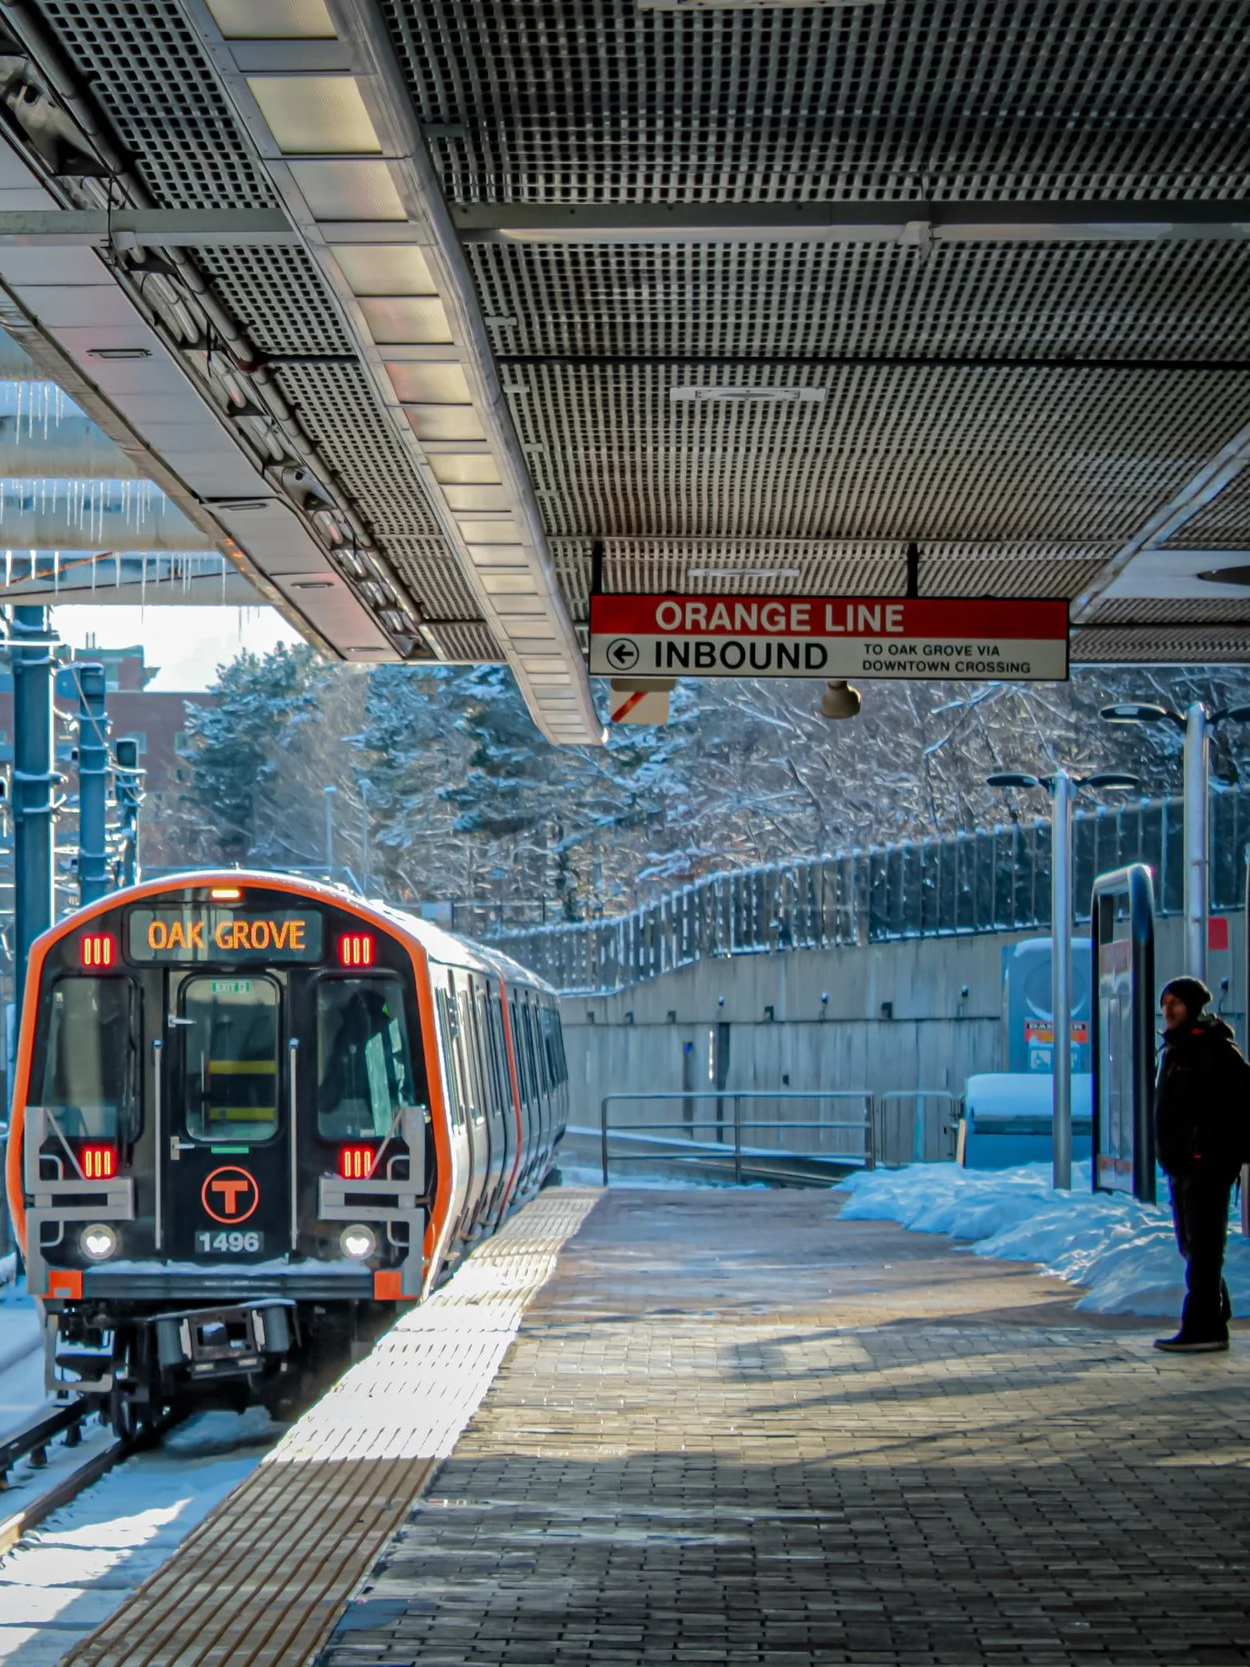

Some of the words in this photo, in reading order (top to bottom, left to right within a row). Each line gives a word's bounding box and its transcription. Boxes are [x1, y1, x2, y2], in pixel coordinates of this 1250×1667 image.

[655, 600, 811, 632] ORANGE
[825, 603, 904, 632] LINE
[655, 640, 828, 670] INBOUND
[863, 643, 883, 656] TO
[888, 643, 918, 656] OAK
[922, 644, 973, 657] GROVE
[977, 645, 1000, 657] VIA
[862, 660, 950, 672] DOWNTOWN
[955, 661, 1031, 674] CROSSING
[147, 920, 205, 949] OAK
[214, 920, 306, 949] GROVE
[211, 1180, 249, 1214] T
[199, 1231, 260, 1252] 1496
